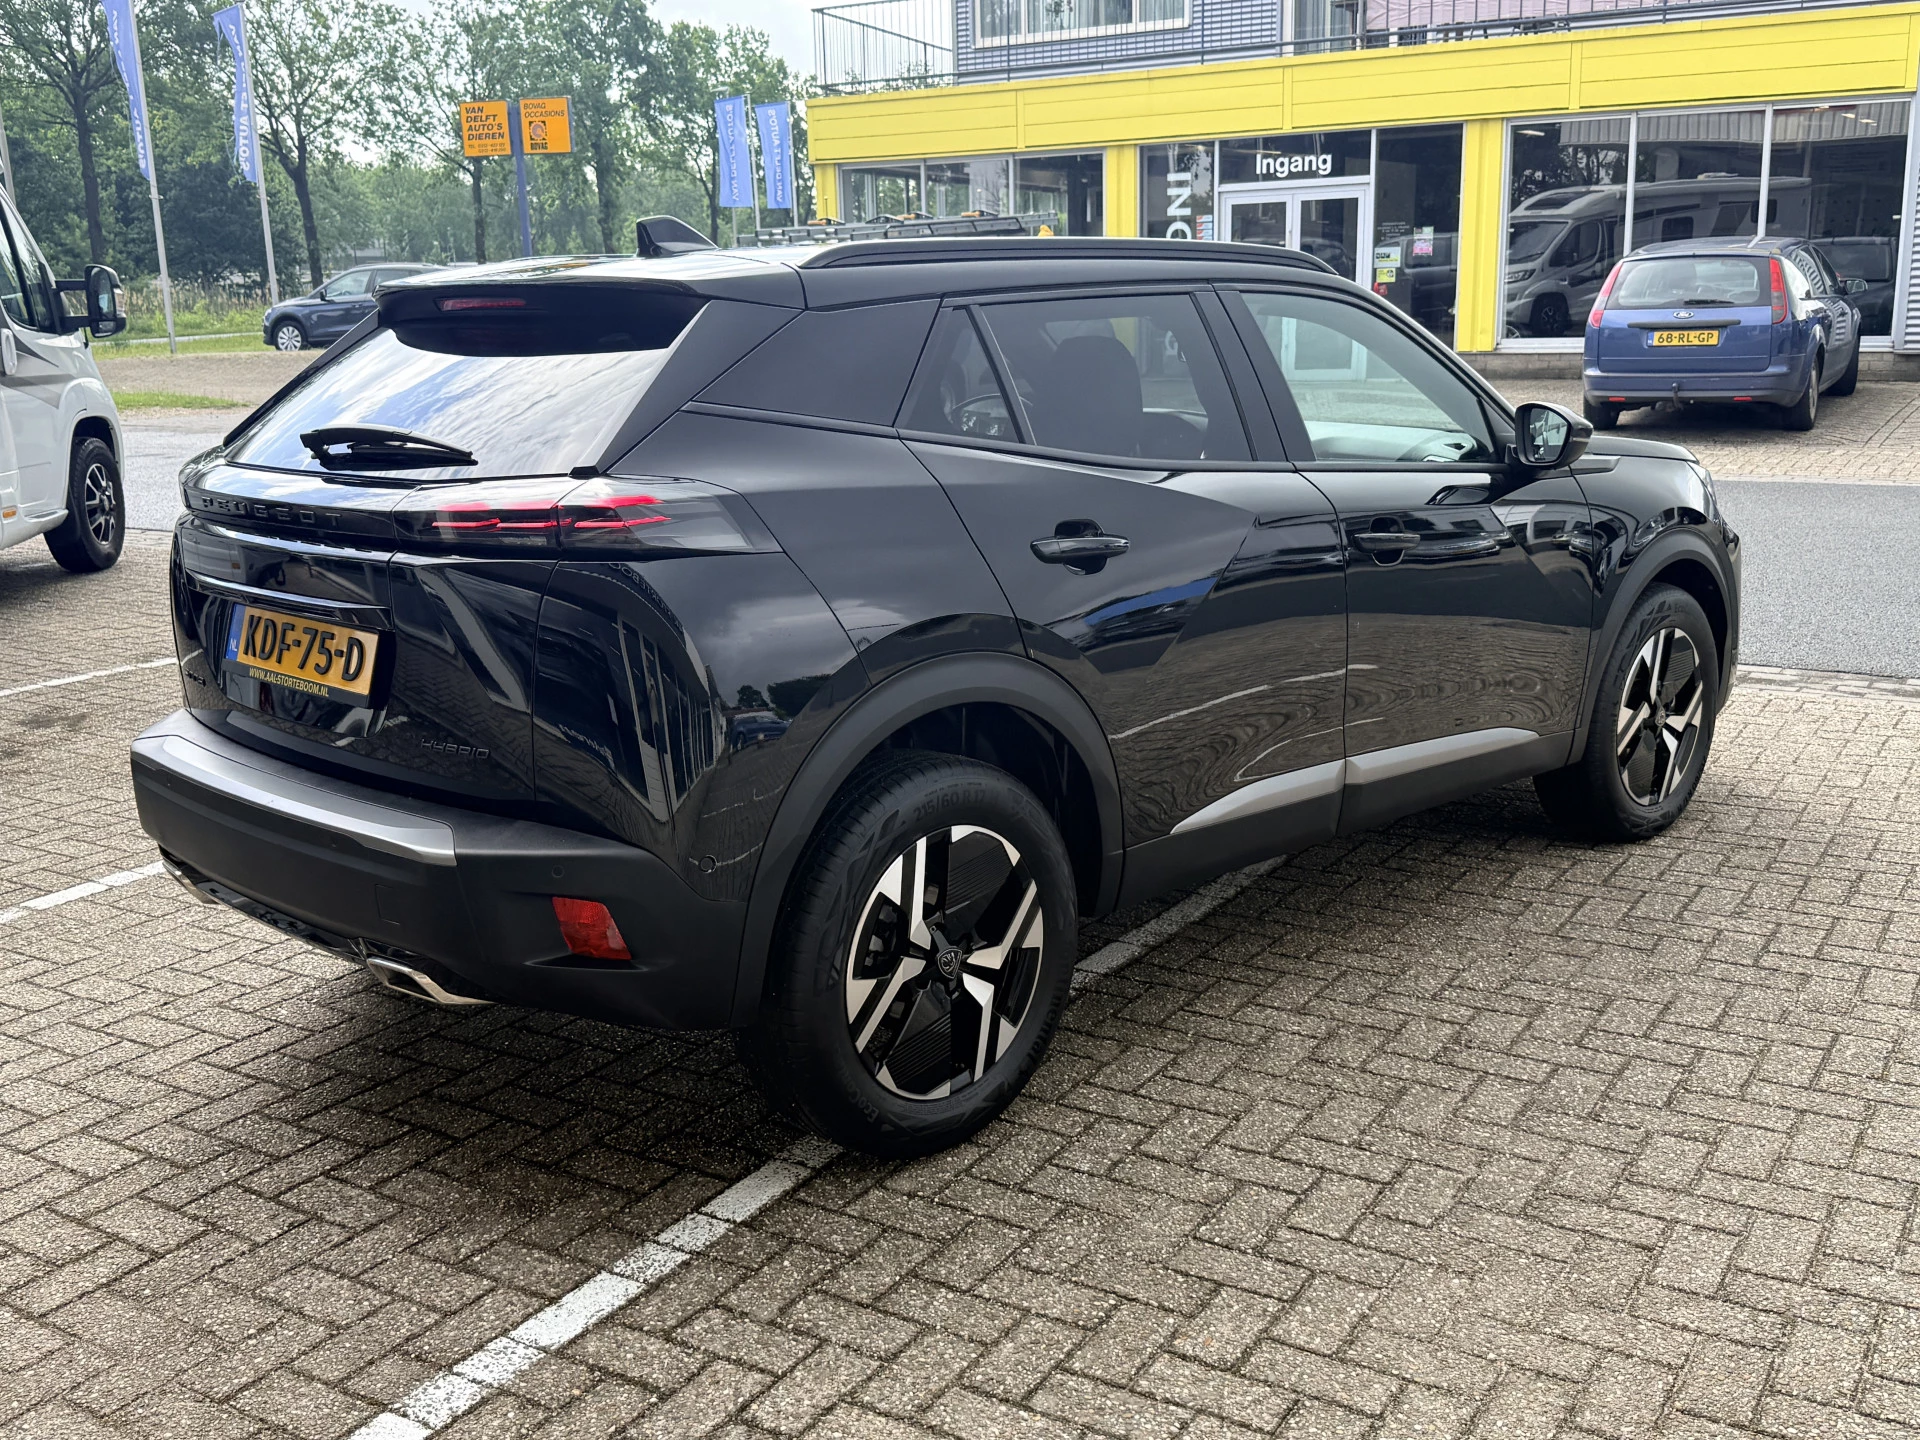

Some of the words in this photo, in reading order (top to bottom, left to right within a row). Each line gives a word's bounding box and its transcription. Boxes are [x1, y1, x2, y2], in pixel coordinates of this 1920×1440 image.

[465, 106, 484, 115] VAN
[523, 102, 546, 110] BOVAG
[466, 114, 498, 123] DELFT
[524, 110, 565, 118] OCCASIONS
[467, 123, 503, 132] AUTO'S
[467, 132, 505, 141] DIEREN
[1255, 152, 1333, 178] Ingang
[1657, 332, 1714, 344] 68-RL-GP
[201, 496, 343, 526] PEUGEOT
[229, 638, 238, 652] NL
[243, 614, 364, 682] KDF-75-D
[420, 738, 489, 759] HYBRID
